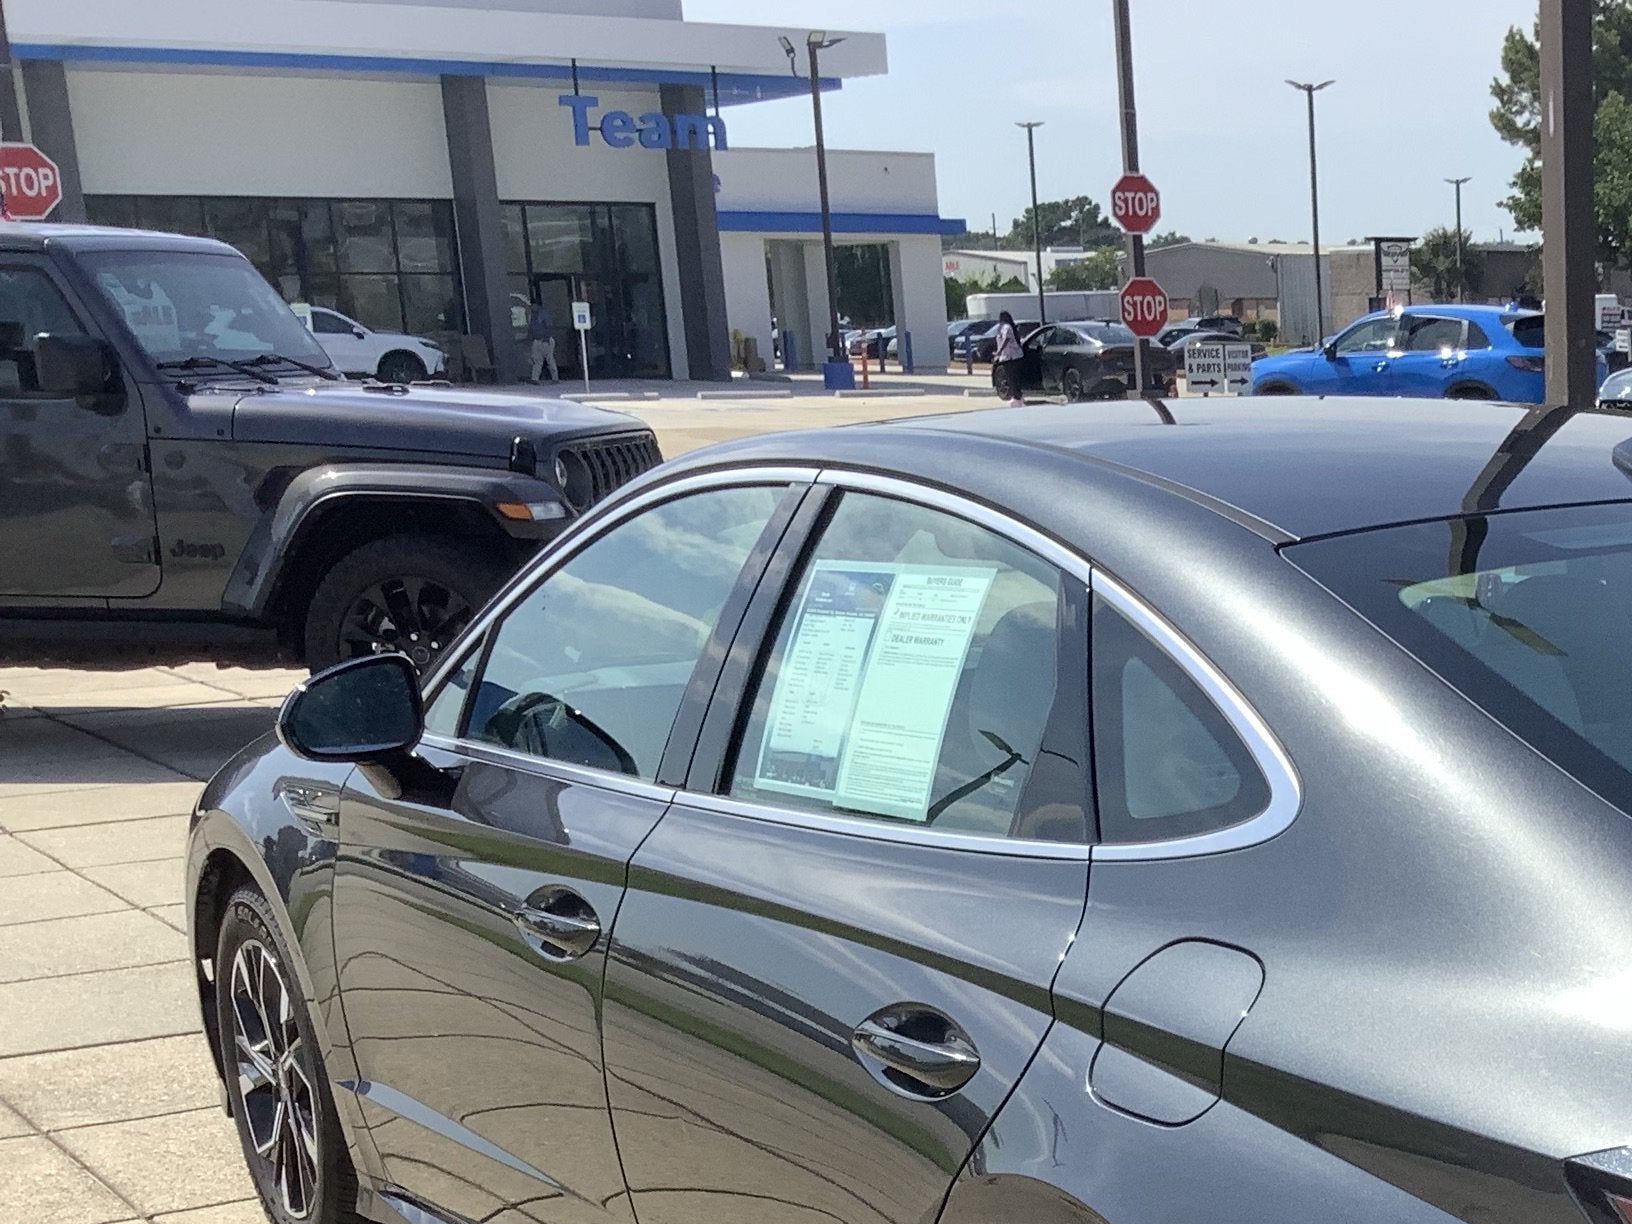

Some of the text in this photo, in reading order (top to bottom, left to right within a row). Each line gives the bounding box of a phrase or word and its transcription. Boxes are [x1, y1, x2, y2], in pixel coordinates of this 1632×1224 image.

[558, 95, 728, 150] Team
[1114, 191, 1158, 217] STOP
[1123, 296, 1166, 321] STOP
[1187, 348, 1221, 359] SERVICE
[1196, 362, 1222, 374] PARTS
[170, 539, 225, 560] Jeep
